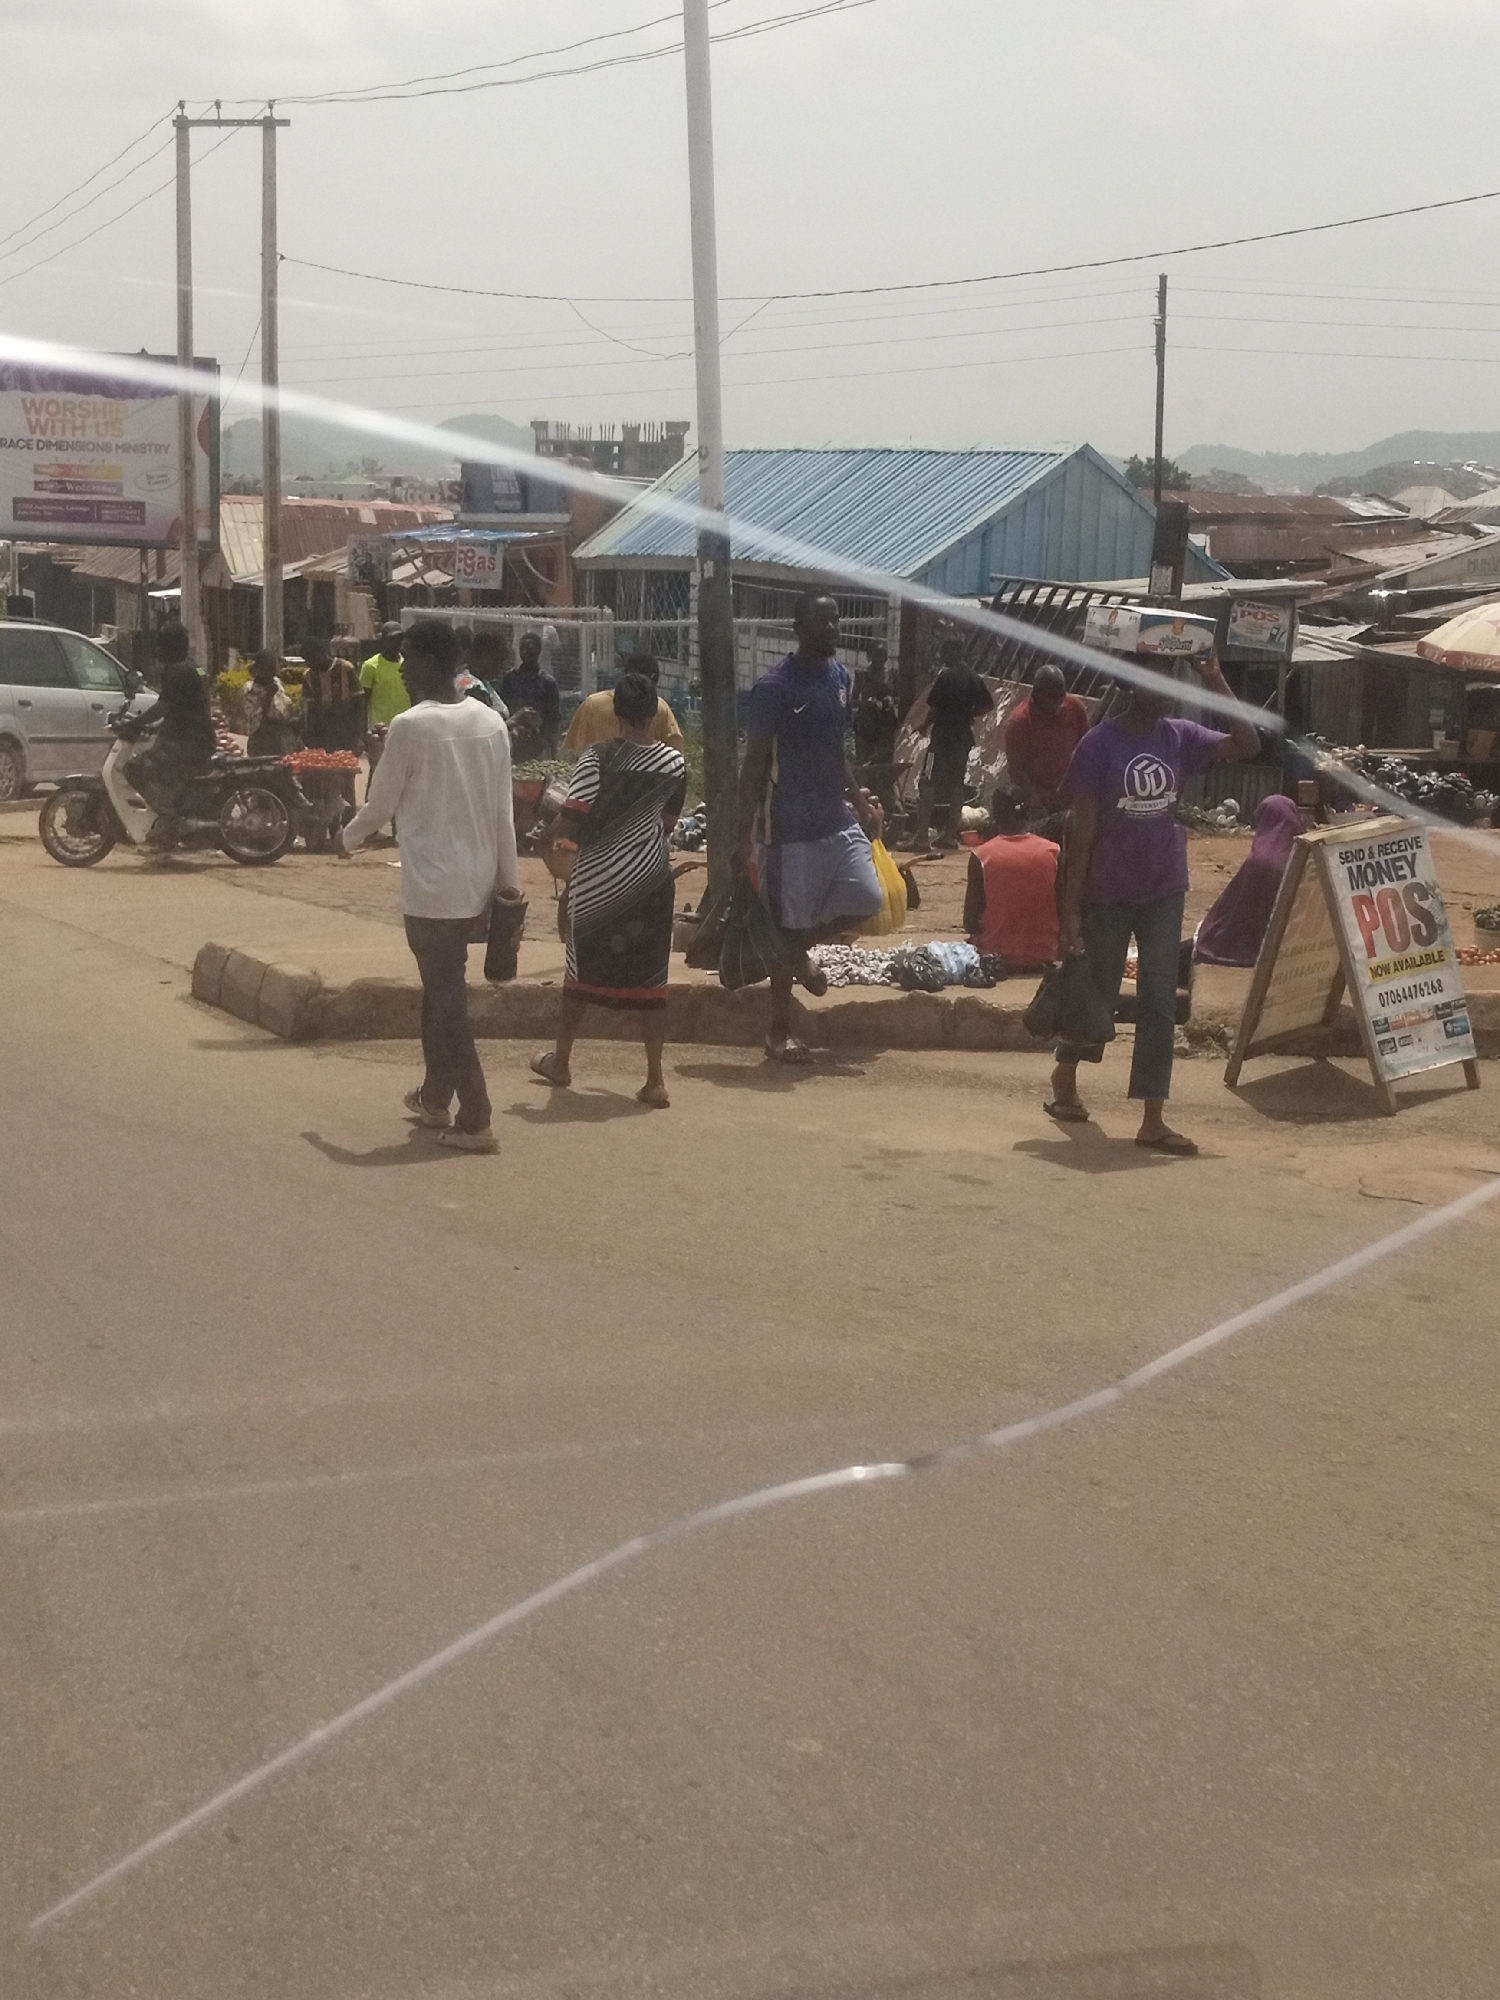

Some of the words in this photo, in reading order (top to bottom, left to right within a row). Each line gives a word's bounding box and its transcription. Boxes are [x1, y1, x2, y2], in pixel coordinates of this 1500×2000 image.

[21, 397, 129, 419] WORSHIP
[27, 417, 87, 437] WITH
[94, 419, 125, 438] US
[36, 440, 113, 453] DIMENSIONS
[115, 443, 171, 455] MINISTRY
[1240, 609, 1281, 622] POS
[1339, 848, 1365, 865] SEND
[1368, 846, 1375, 860] &
[1378, 836, 1423, 857] RECEIVE
[1347, 852, 1416, 891] MONEY
[1352, 881, 1439, 958] POS
[1369, 963, 1391, 979] NOW
[1393, 950, 1445, 974] AVAILABLE
[1378, 978, 1443, 1008] 07064476268
